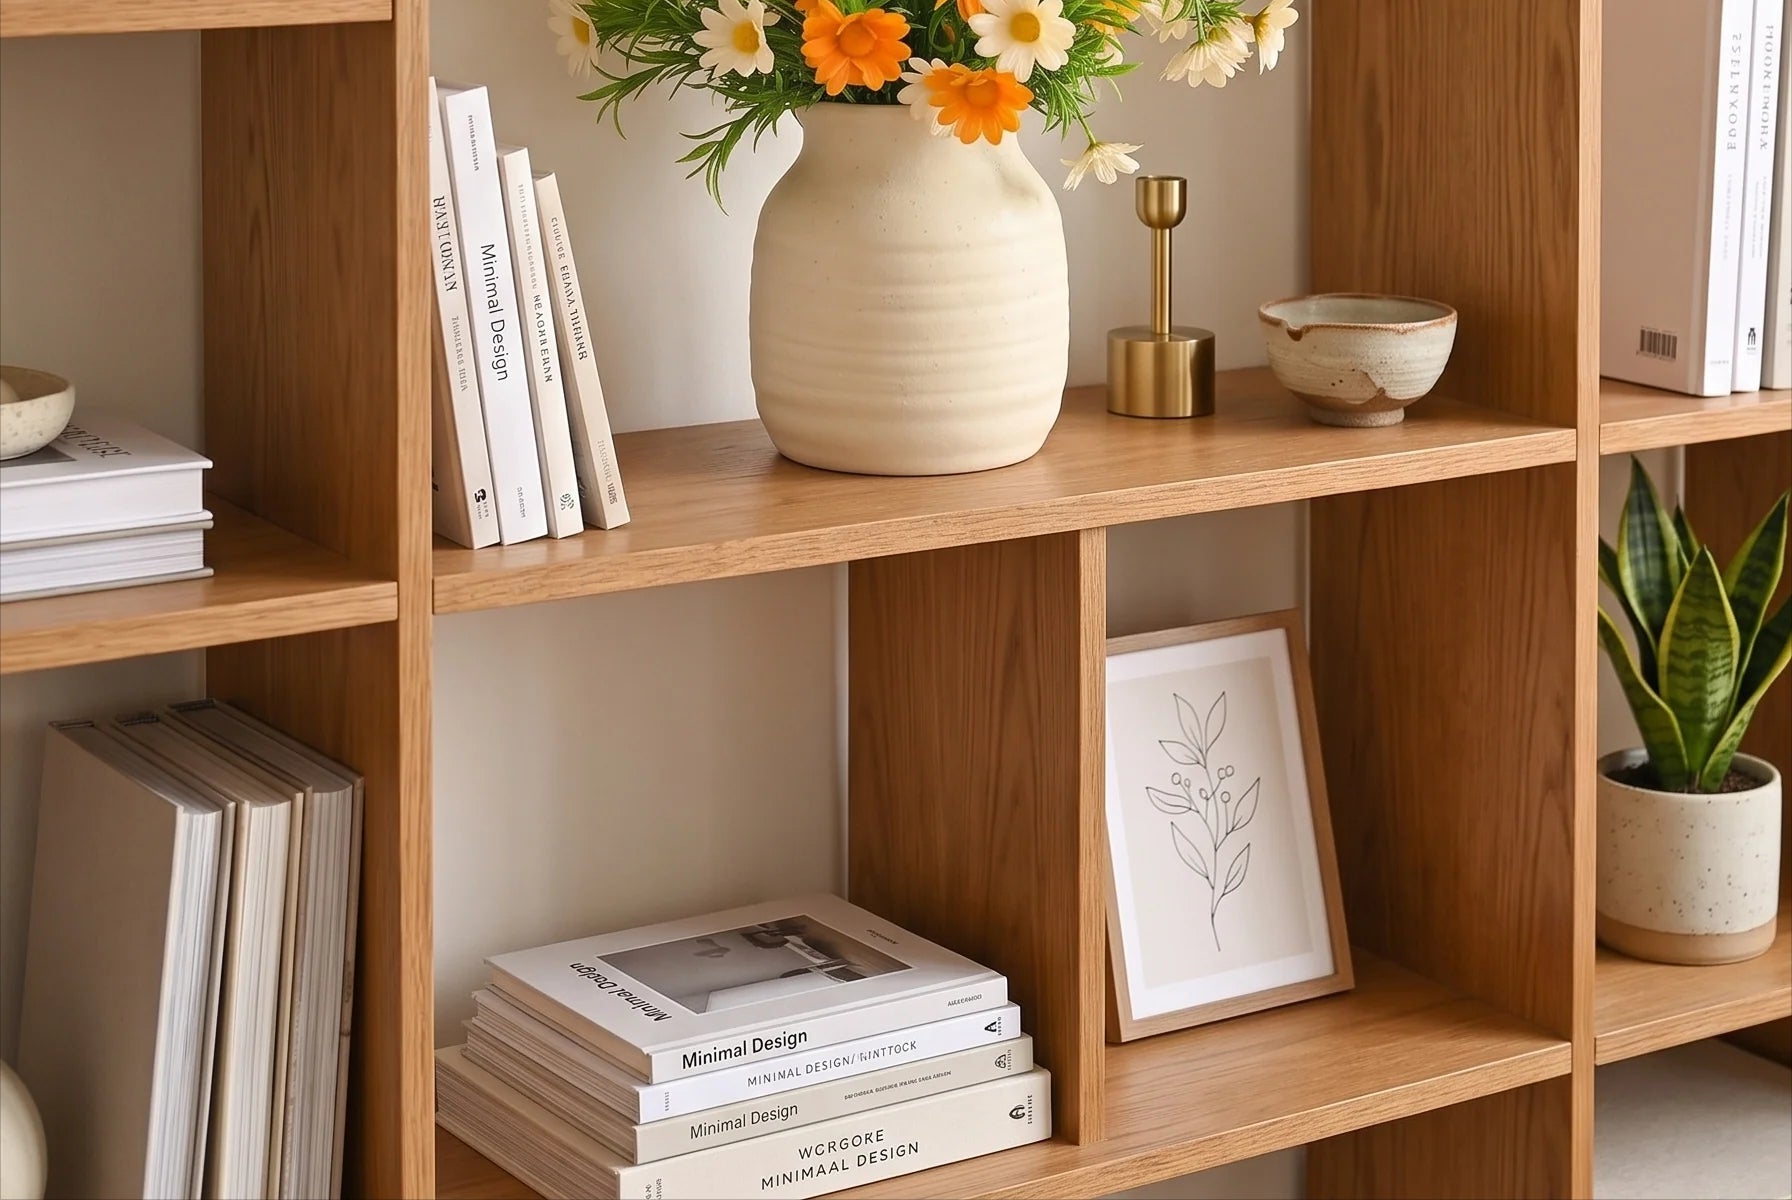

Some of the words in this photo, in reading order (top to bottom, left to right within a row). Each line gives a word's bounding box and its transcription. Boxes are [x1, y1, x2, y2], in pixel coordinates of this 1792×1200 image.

[480, 244, 504, 314] Minimal
[490, 319, 509, 381] Design
[682, 1040, 747, 1070] Minimal
[752, 1030, 808, 1053] Design
[747, 1066, 802, 1088] MINIMAL
[690, 1113, 746, 1140] Minimal
[751, 1104, 798, 1126] Design
[761, 1159, 850, 1190] MINIMAAL
[857, 1141, 919, 1167] DESIGN
